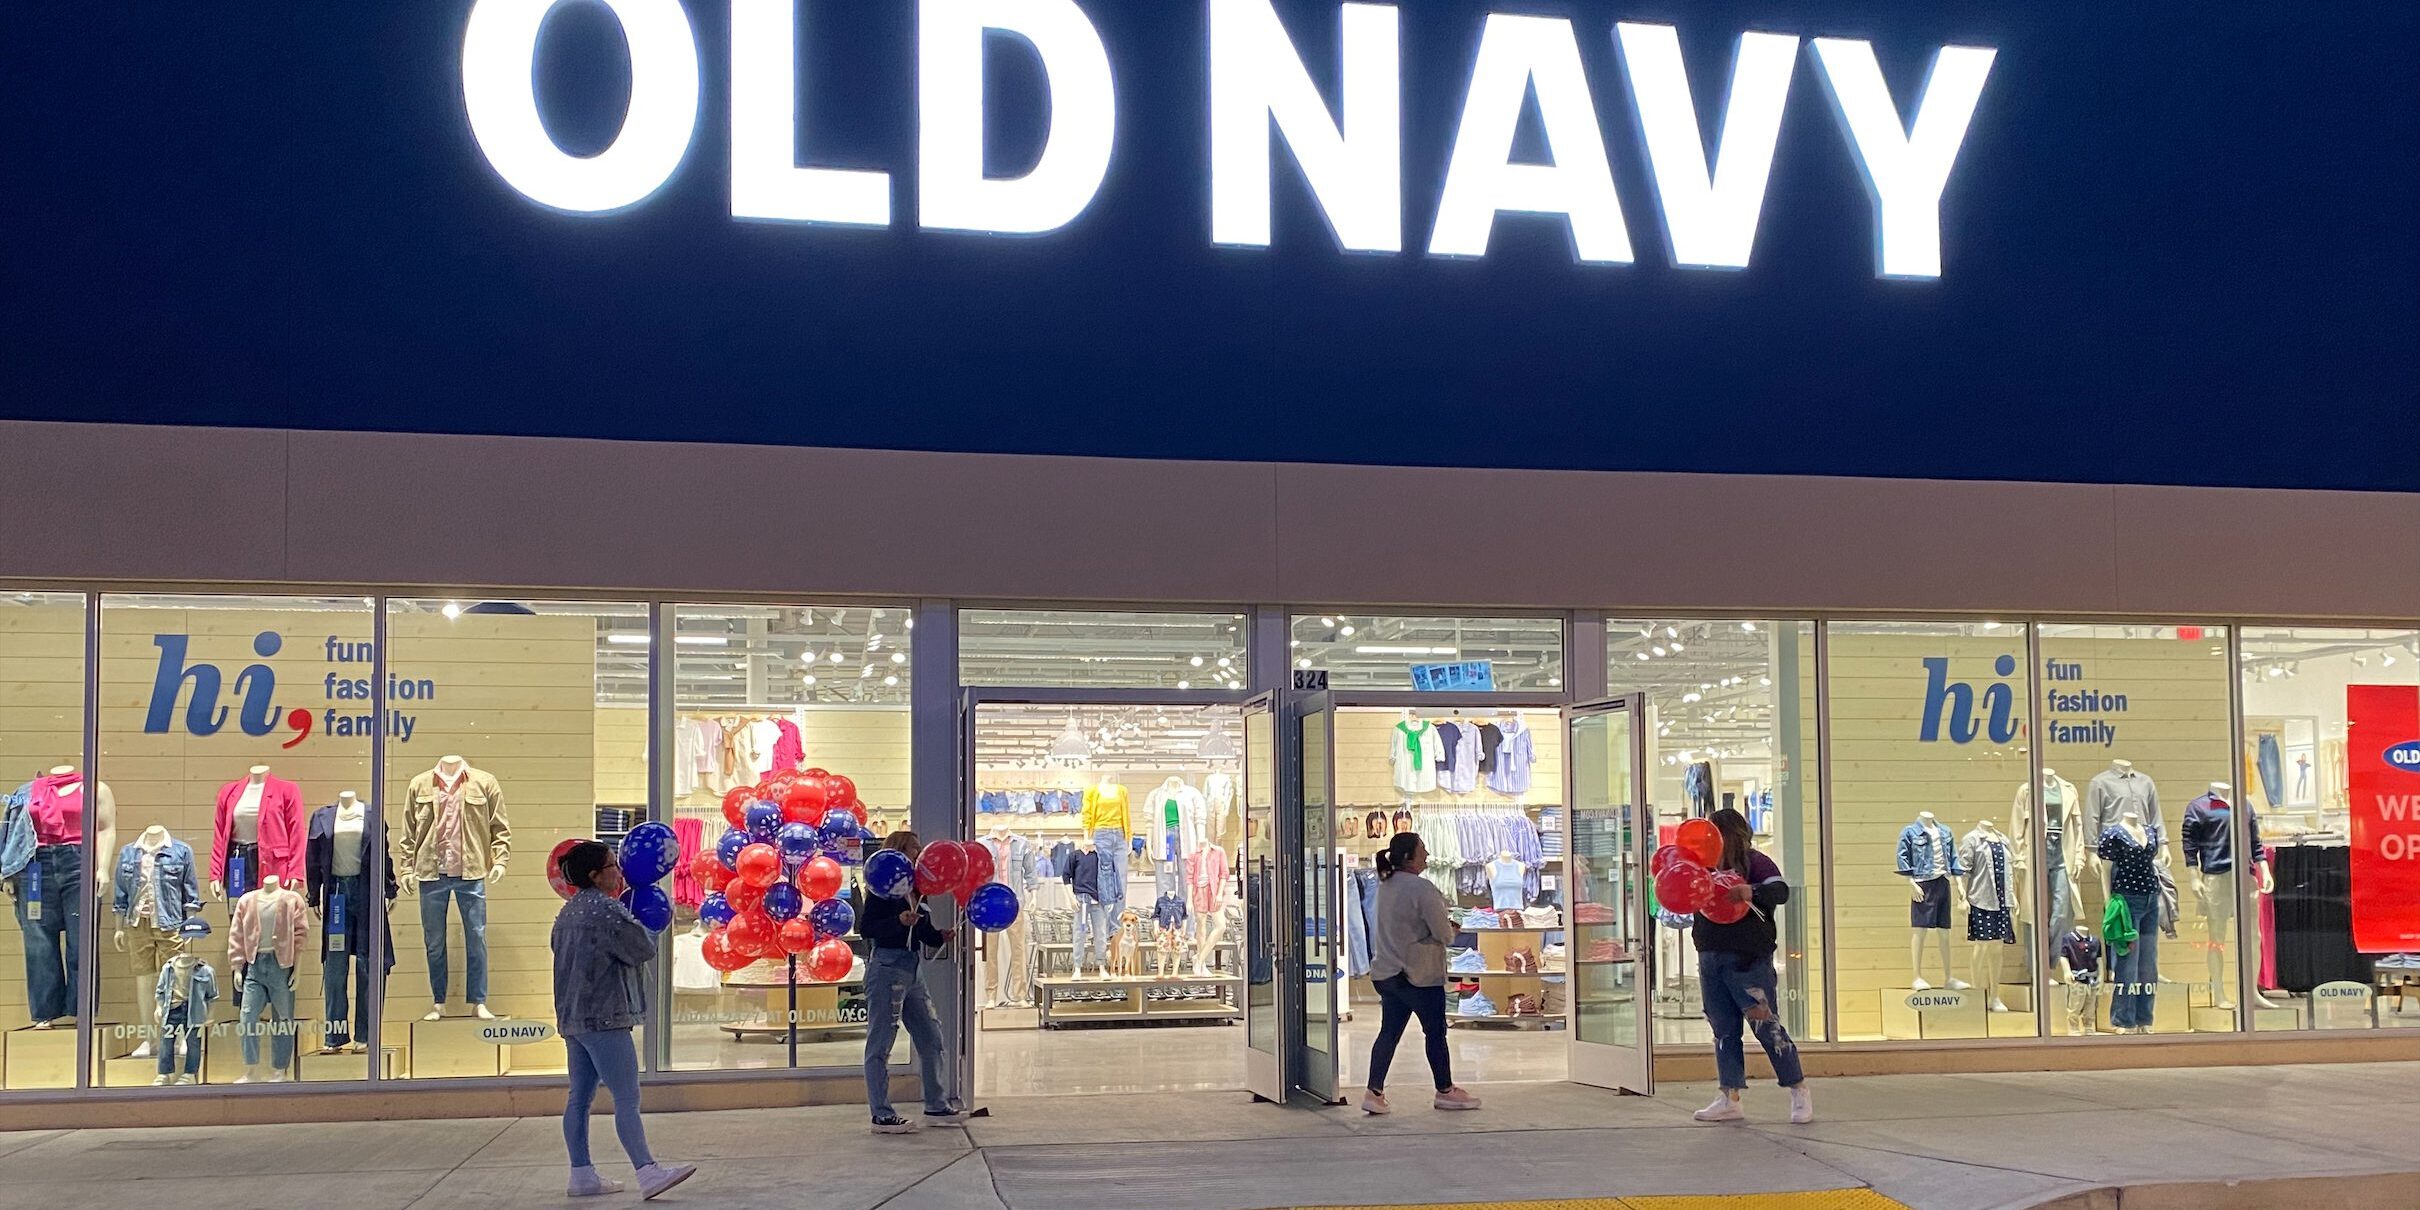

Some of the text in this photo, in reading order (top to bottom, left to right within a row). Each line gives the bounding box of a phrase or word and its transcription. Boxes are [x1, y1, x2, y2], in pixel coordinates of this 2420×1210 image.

[462, 0, 1998, 279] OLD NAVY
[325, 636, 372, 662] fun
[2047, 658, 2082, 681] fun
[1294, 670, 1327, 689] 324
[1920, 655, 2026, 744] hi
[2048, 690, 2127, 712] fashion
[2049, 720, 2116, 747] family
[2393, 749, 2420, 764] OLD
[2128, 983, 2142, 995] AT
[2320, 988, 2365, 997] OLD NAVY
[1912, 996, 1960, 1006] OLD NAVY
[114, 1025, 158, 1039] OPEN
[164, 1023, 203, 1039] 24/7
[210, 1024, 230, 1038] AT
[483, 1026, 546, 1038] OLD NAVY
